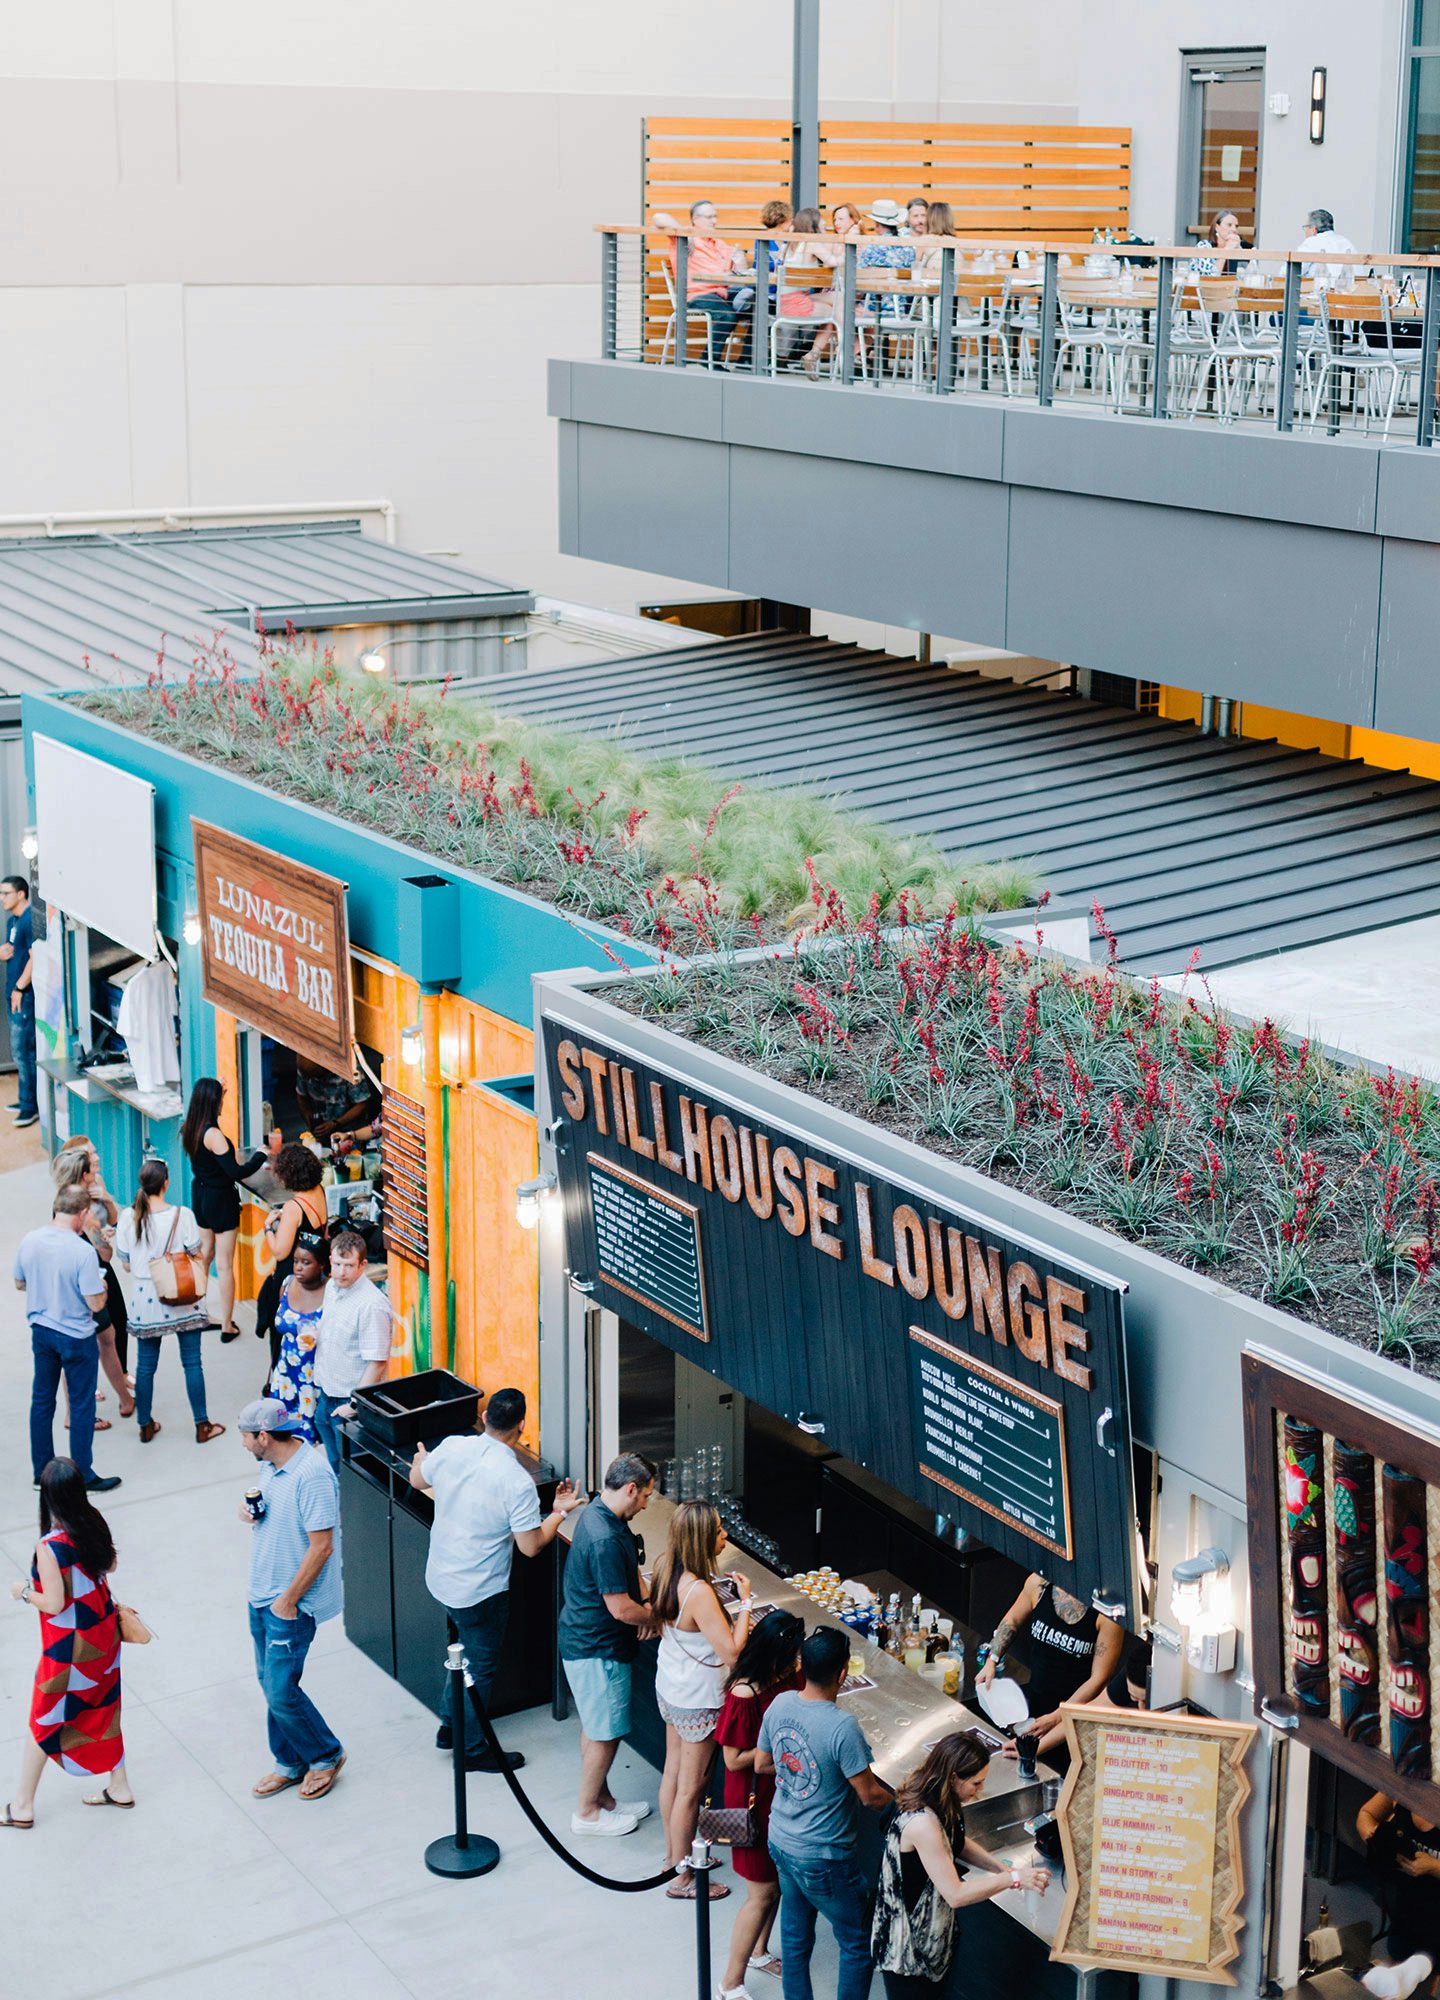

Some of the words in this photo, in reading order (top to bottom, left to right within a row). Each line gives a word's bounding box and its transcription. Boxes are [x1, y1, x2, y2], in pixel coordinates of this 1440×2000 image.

[216, 876, 323, 953] LUNAZUL
[209, 914, 289, 994] TEQUILA
[295, 956, 336, 1021] BAR
[557, 1039, 844, 1260] STILLHOUSE
[855, 1181, 1093, 1392] LOUNGE
[920, 1359, 941, 1378] MOSCOW
[942, 1371, 956, 1388] MULE
[967, 1377, 1003, 1403] COCKTAIL
[1004, 1396, 1010, 1407] &
[1011, 1400, 1035, 1420] WINES
[1105, 1733, 1147, 1746] PAINKILLER
[1156, 1739, 1163, 1748] 11
[1104, 1757, 1119, 1766] FOG
[1120, 1759, 1150, 1770] CUTTER
[1159, 1763, 1168, 1772] 10
[1103, 1787, 1144, 1800] SINGAPORE
[1102, 1817, 1120, 1827] BLUE
[1129, 1867, 1158, 1879] STORMY
[1113, 1889, 1141, 1901] ISLAND
[1142, 1893, 1174, 1905] FASHION
[1097, 1917, 1127, 1928] BANANA
[1129, 1921, 1163, 1933] HAMMOCK
